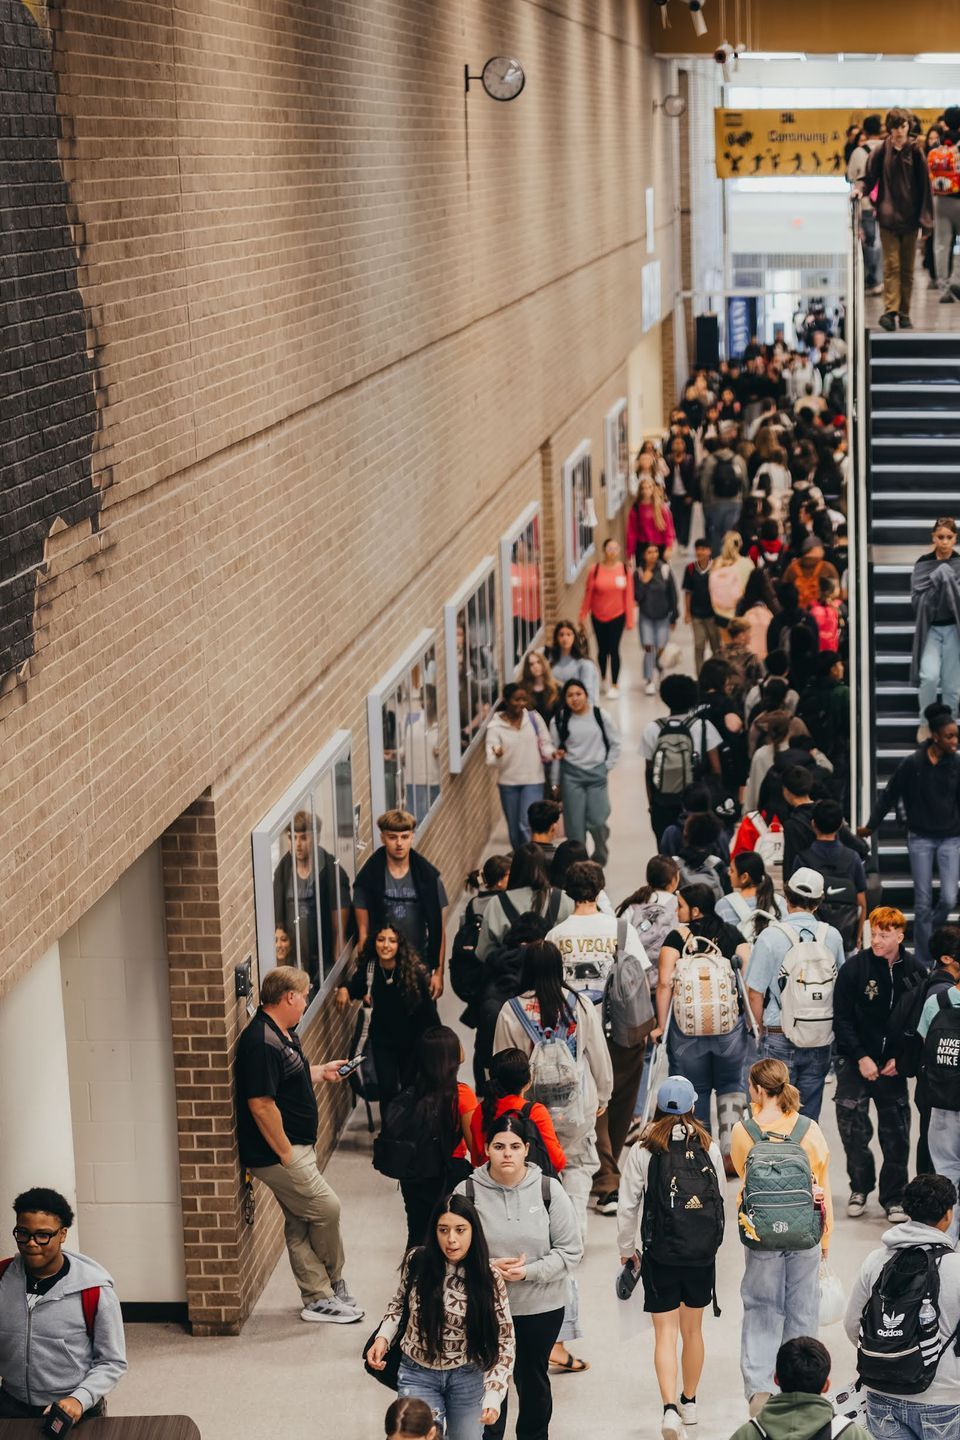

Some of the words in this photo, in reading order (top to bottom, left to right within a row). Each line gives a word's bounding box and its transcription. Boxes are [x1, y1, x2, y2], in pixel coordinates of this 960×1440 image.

[940, 1038, 960, 1048] NIKE
[937, 1046, 960, 1056] NIKE
[936, 1055, 958, 1066] NIKE
